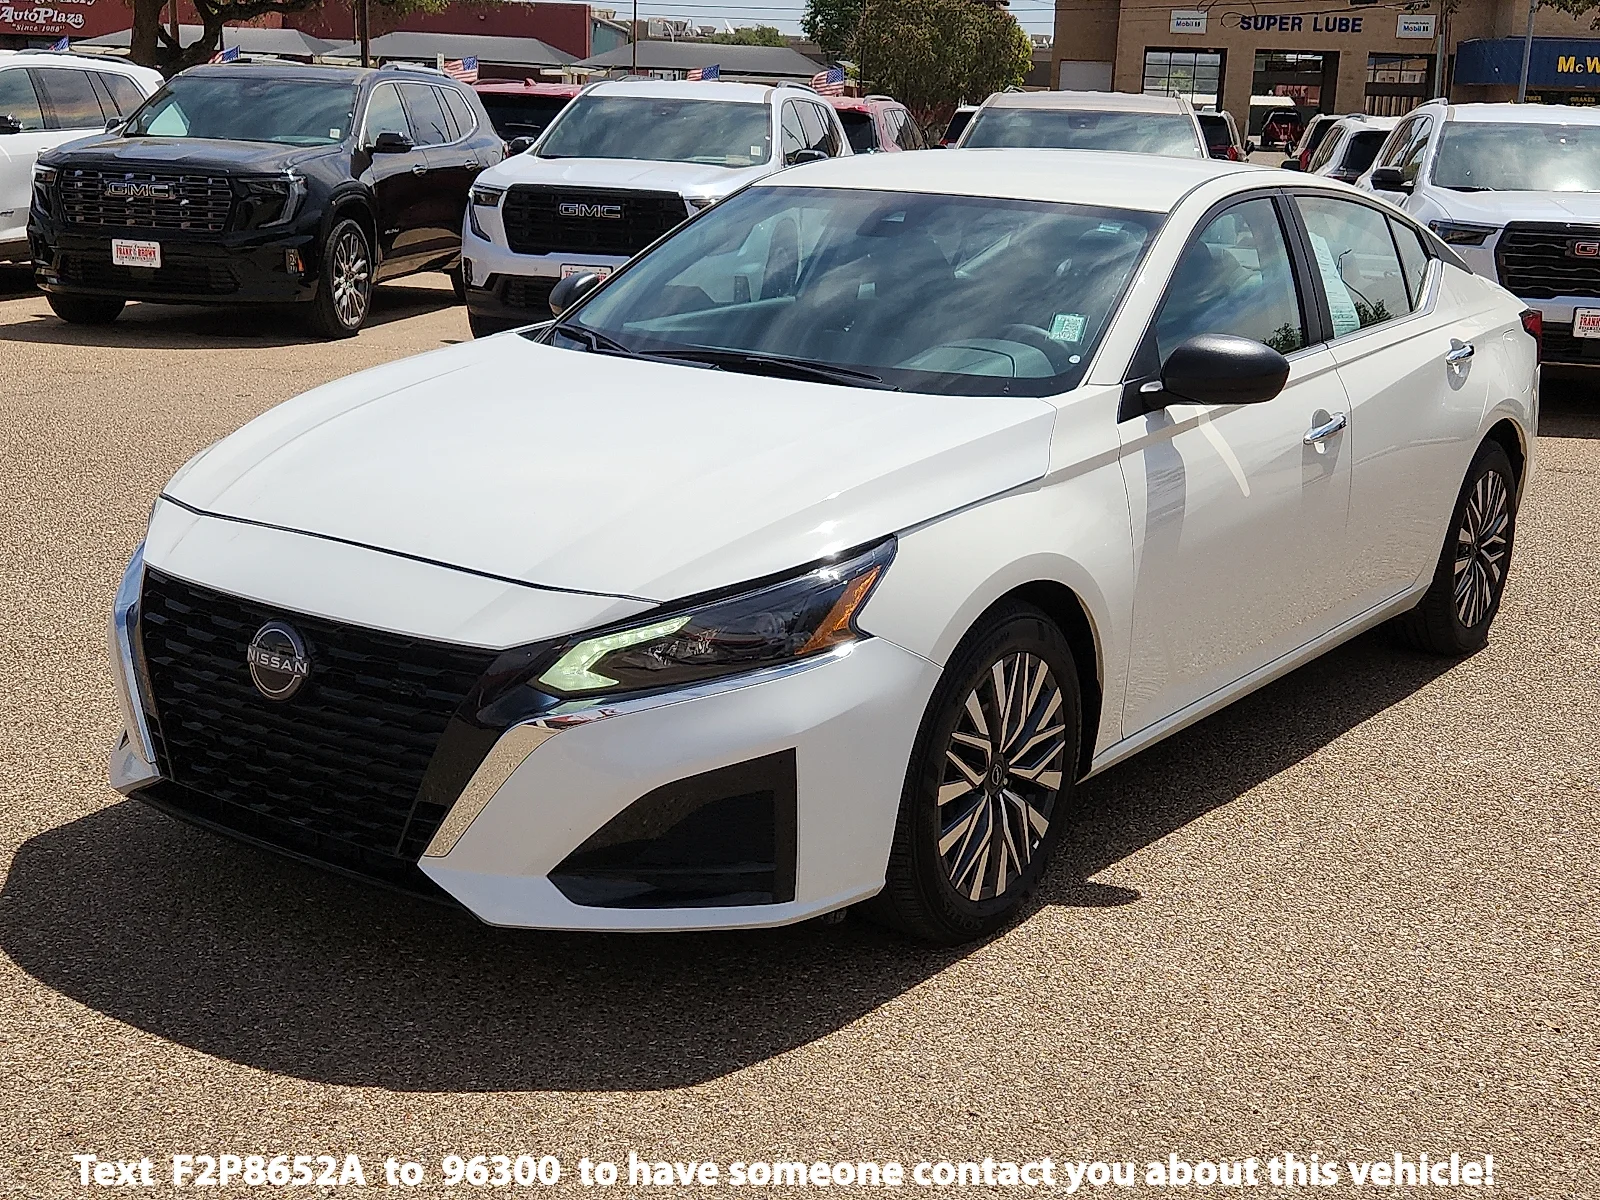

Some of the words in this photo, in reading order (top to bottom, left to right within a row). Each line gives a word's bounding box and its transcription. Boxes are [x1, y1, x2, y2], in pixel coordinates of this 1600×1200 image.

[1239, 15, 1303, 32] SUPER
[1312, 16, 1363, 33] LUBE
[1403, 24, 1422, 32] Mobil
[108, 182, 169, 198] GMC
[559, 203, 621, 219] GMC
[247, 646, 308, 674] NISSAN
